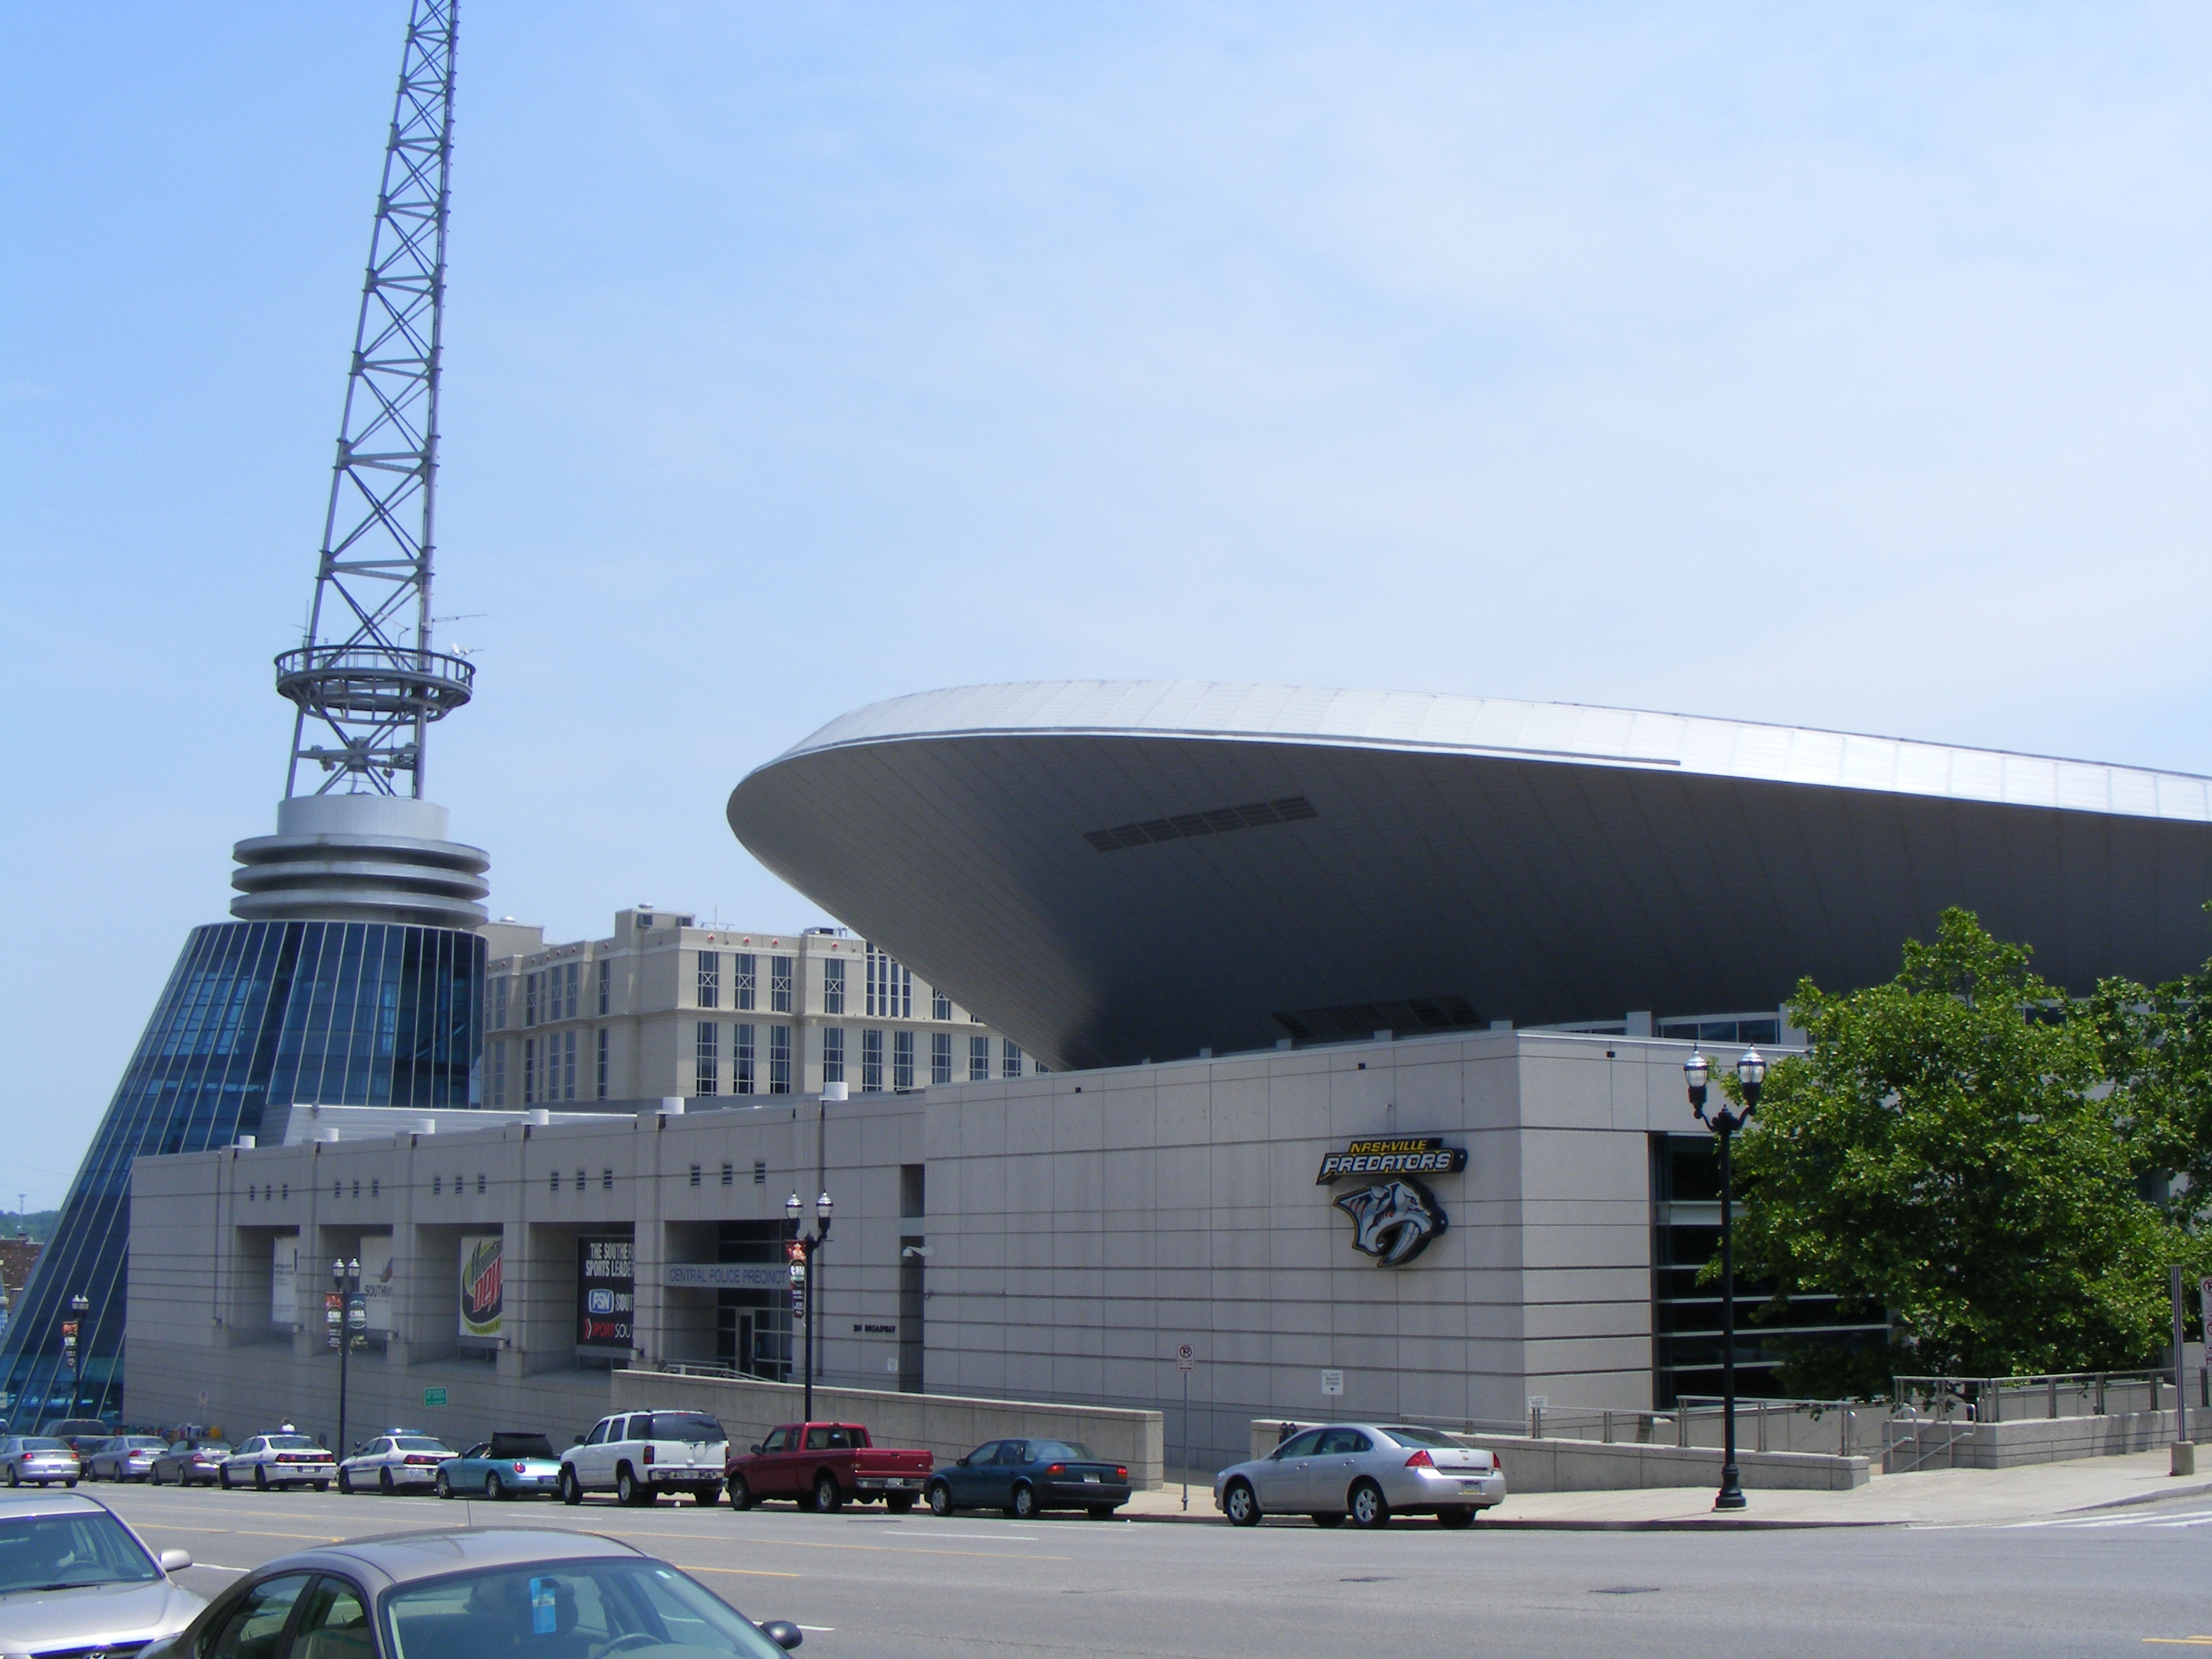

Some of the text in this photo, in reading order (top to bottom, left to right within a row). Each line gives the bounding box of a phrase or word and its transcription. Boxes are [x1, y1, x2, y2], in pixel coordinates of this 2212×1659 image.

[1350, 1140, 1427, 1153] NASHVILLE
[1323, 1152, 1453, 1174] PREDATORS
[590, 1243, 603, 1259] THE
[585, 1260, 611, 1277] SPORTS
[670, 1268, 786, 1284] CENTRAL POLICE PRECINCT
[592, 1291, 611, 1310] FSN
[865, 1324, 896, 1333] BROADWAY
